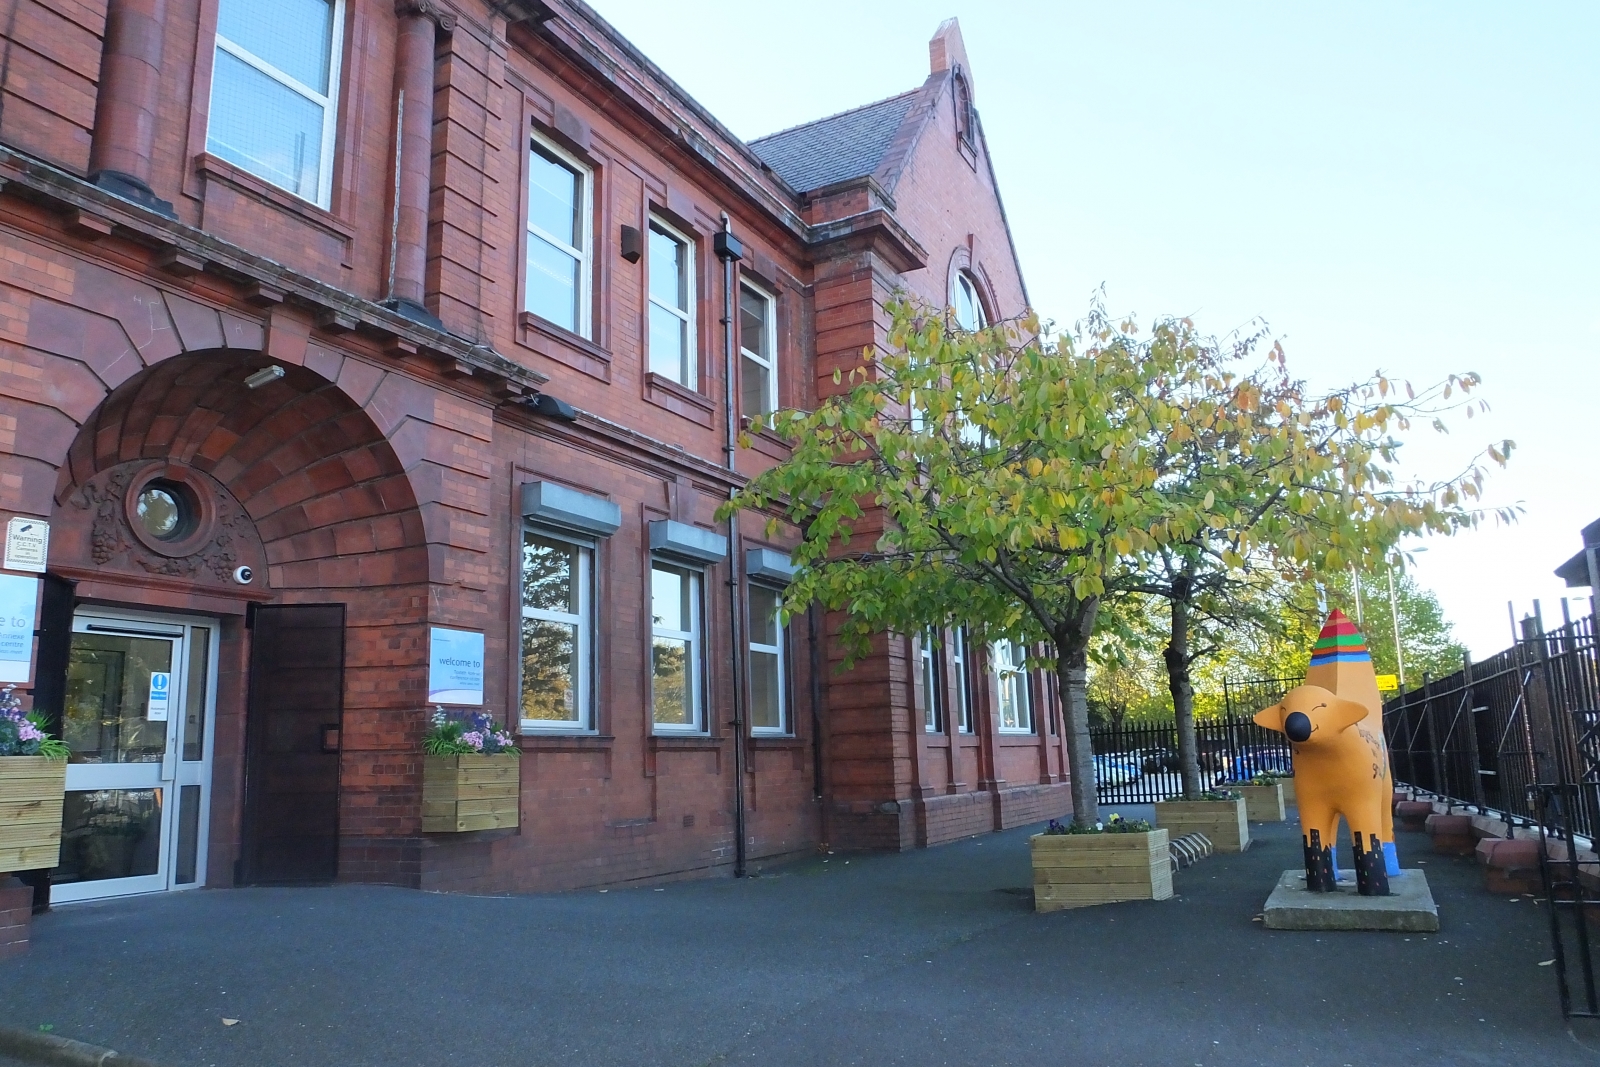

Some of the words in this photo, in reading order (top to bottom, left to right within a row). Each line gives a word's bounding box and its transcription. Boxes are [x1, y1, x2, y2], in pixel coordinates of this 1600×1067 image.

[12, 534, 43, 545] Warning
[11, 616, 26, 628] to
[439, 656, 472, 668] welcome
[473, 660, 481, 668] to
